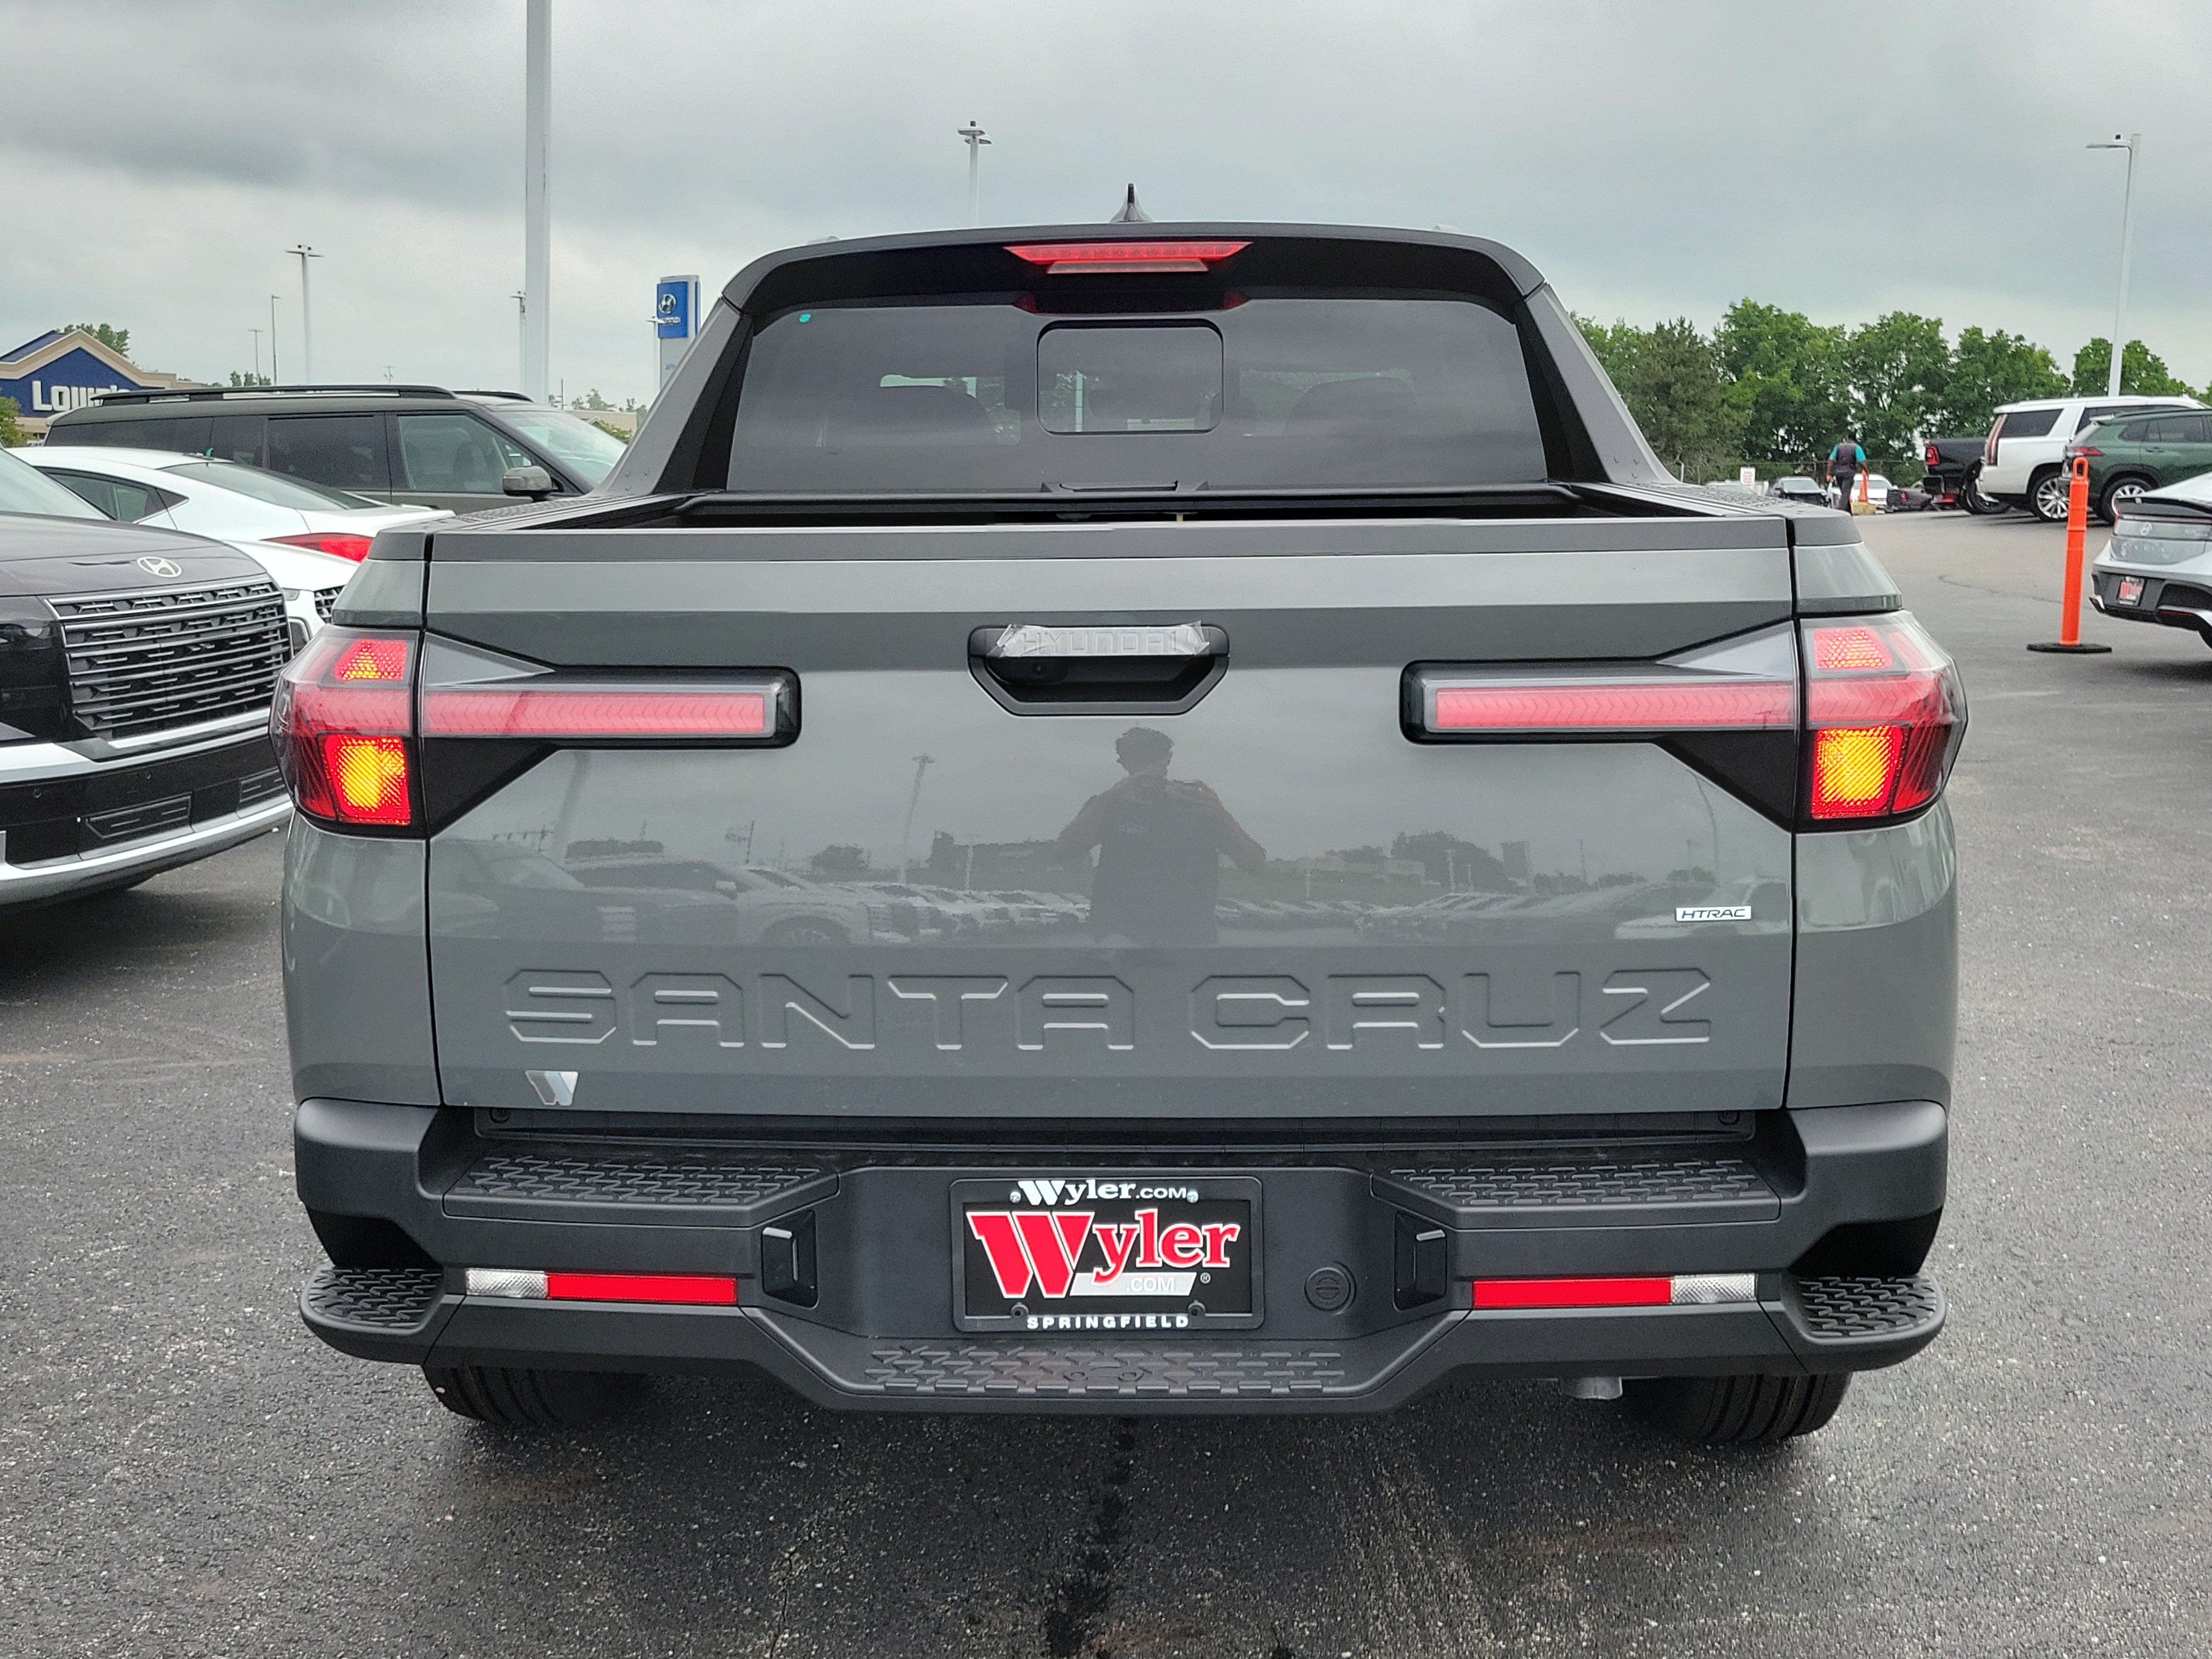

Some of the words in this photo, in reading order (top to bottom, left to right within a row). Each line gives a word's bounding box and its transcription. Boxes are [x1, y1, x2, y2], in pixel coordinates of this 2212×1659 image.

[1681, 909, 1746, 919] HTRAC
[504, 968, 1134, 1051] SANTA
[1190, 967, 1711, 1050] CRUZ
[966, 1208, 1241, 1299] Wyler
[1126, 1276, 1176, 1293] .COM
[1026, 1315, 1189, 1330] SPRINGFIELD
